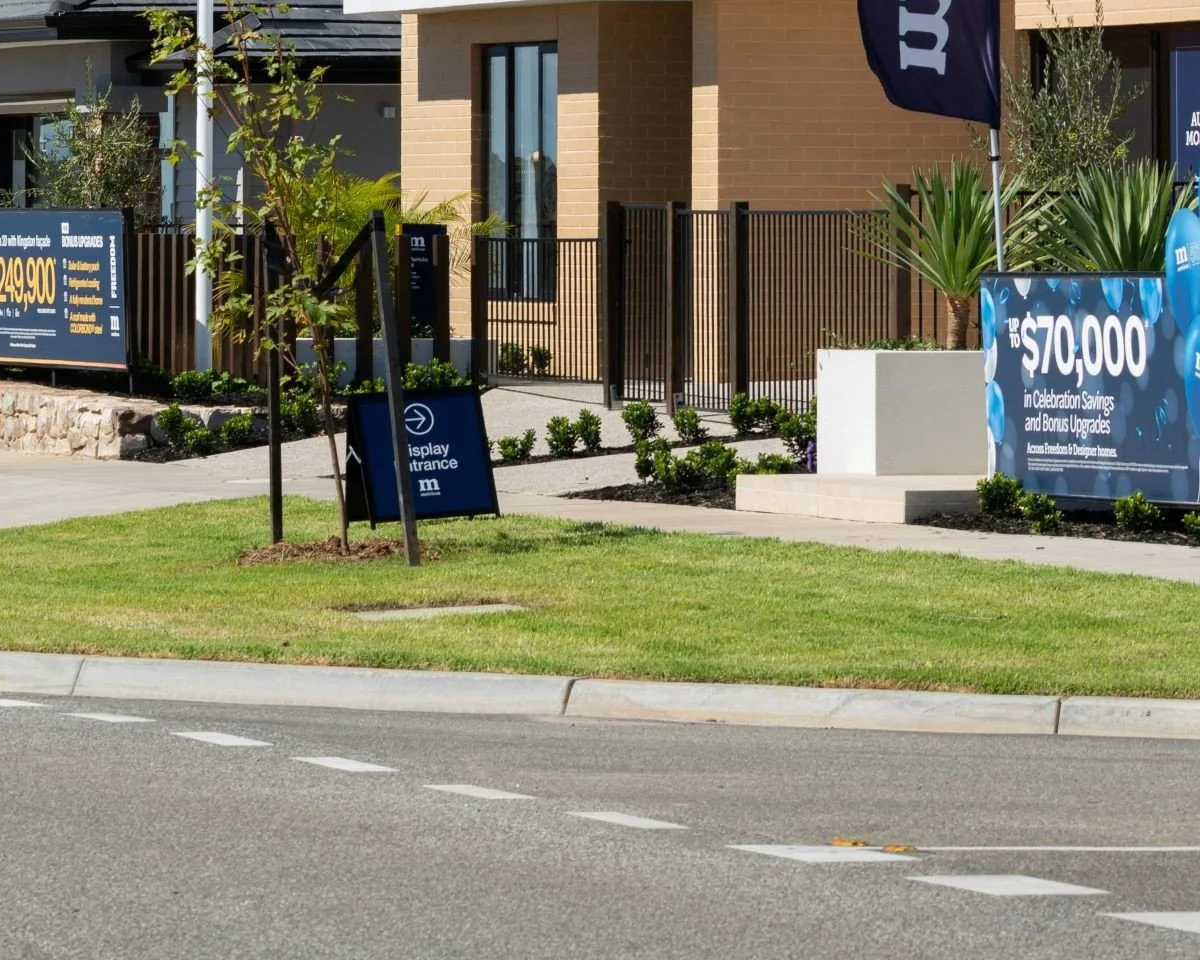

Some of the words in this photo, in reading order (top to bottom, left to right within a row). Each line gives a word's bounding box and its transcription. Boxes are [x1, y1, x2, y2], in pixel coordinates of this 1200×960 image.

[109, 235, 118, 299] FREEDOM
[1008, 317, 1020, 333] UP
[1008, 332, 1021, 349] TO
[1023, 388, 1032, 409] in
[1032, 388, 1080, 409] Celebration
[1081, 390, 1115, 417] Savings
[1024, 411, 1042, 432] and
[1042, 413, 1069, 433] Bonus
[1069, 414, 1111, 440] Upgrades
[408, 442, 449, 459] isplay
[1026, 442, 1044, 455] Across
[1044, 442, 1068, 455] Freedom
[1073, 443, 1097, 459] Designer
[394, 458, 459, 473] trance
